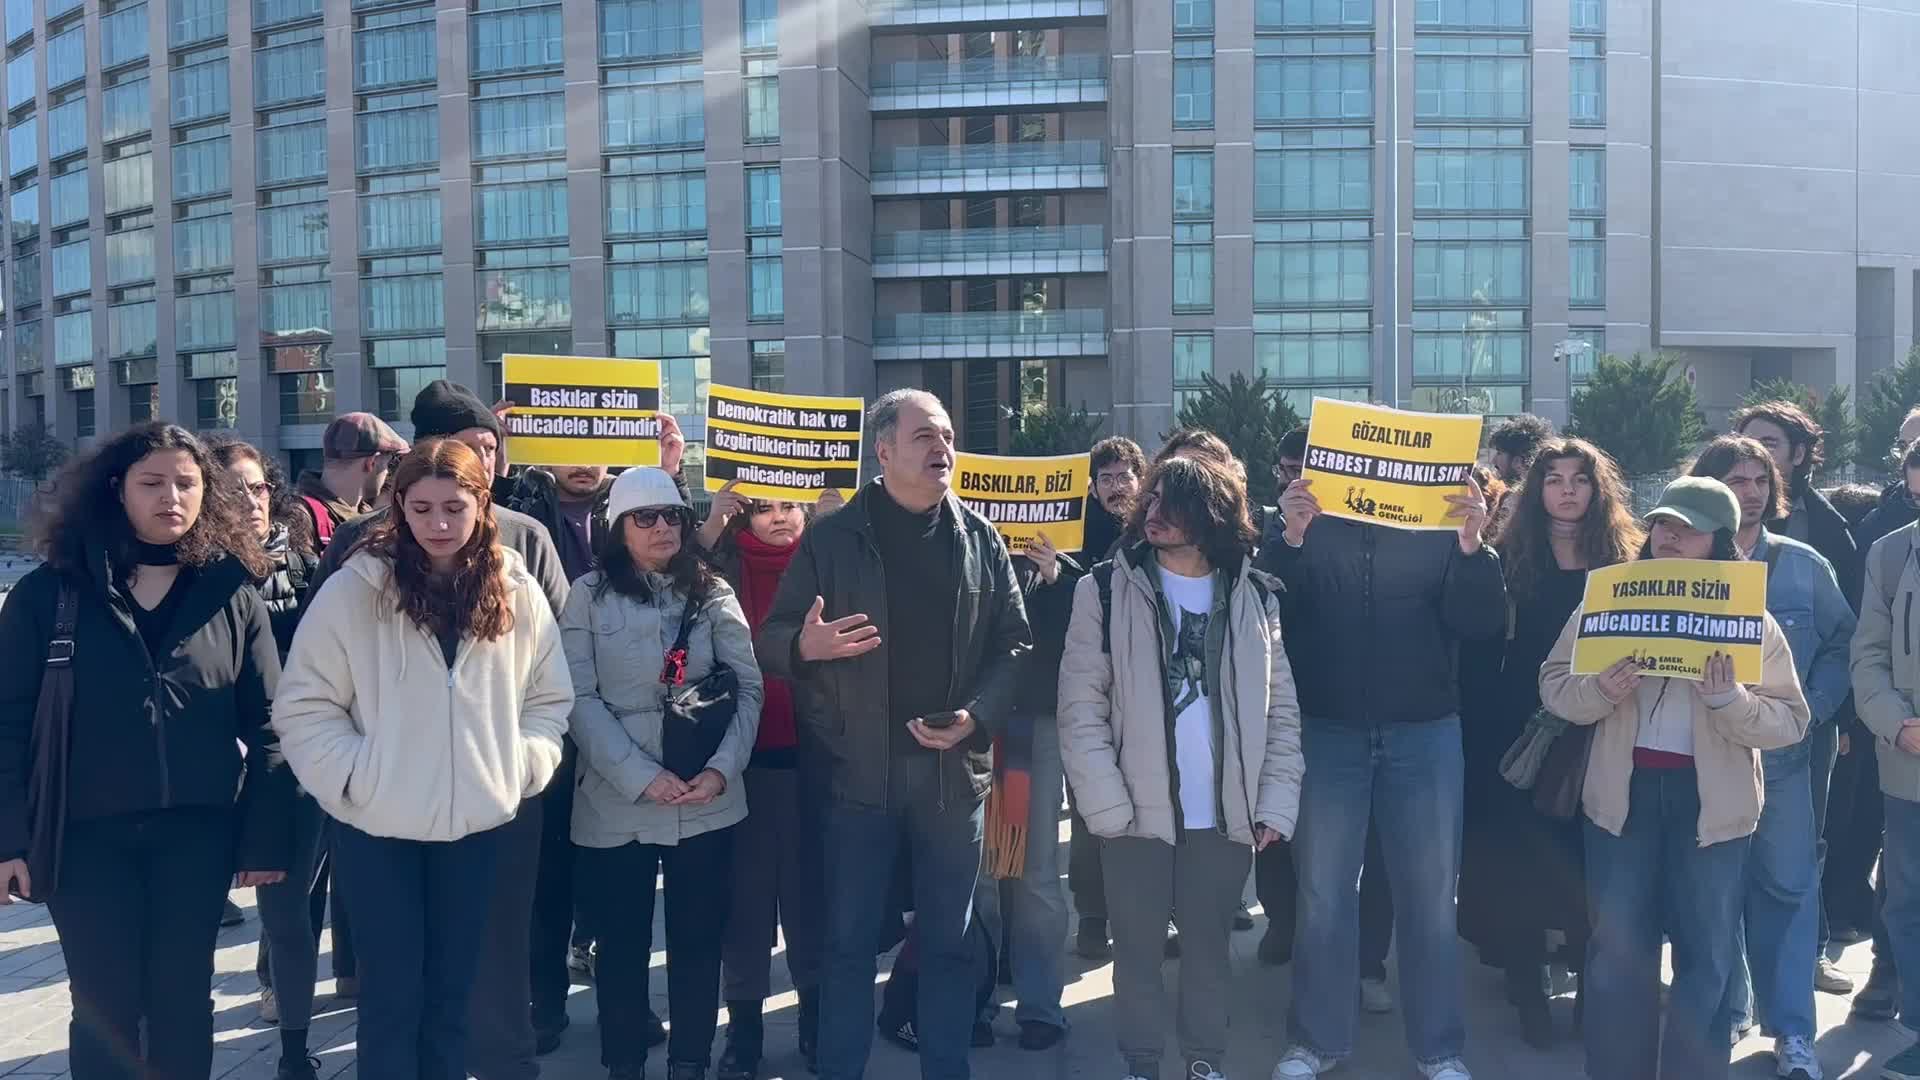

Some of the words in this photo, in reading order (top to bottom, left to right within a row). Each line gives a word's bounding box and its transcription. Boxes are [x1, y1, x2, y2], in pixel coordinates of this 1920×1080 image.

[530, 387, 598, 409] Baskılar
[601, 389, 638, 409] sizin
[507, 414, 588, 435] mücadele
[593, 416, 662, 437] bizimdir!
[717, 400, 796, 427] Demokratik
[800, 411, 826, 428] hak
[830, 416, 847, 428] ve
[715, 430, 822, 458] özgürlüklerimiz
[824, 440, 850, 461] için
[1351, 420, 1432, 449] GÖZALTILAR
[1309, 449, 1373, 475] SERBEST
[736, 466, 825, 488] mücadeleye!
[960, 471, 1040, 495] BASKILAR,
[1045, 469, 1073, 493] BİZİ
[1379, 503, 1404, 513] EMEK
[1612, 580, 1687, 599] YASAKLAR
[1691, 579, 1731, 601] SİZİN
[1584, 612, 1670, 633] MÜCADELE
[1677, 613, 1762, 640] BİZİMDİR!
[1659, 656, 1684, 664] EMEK
